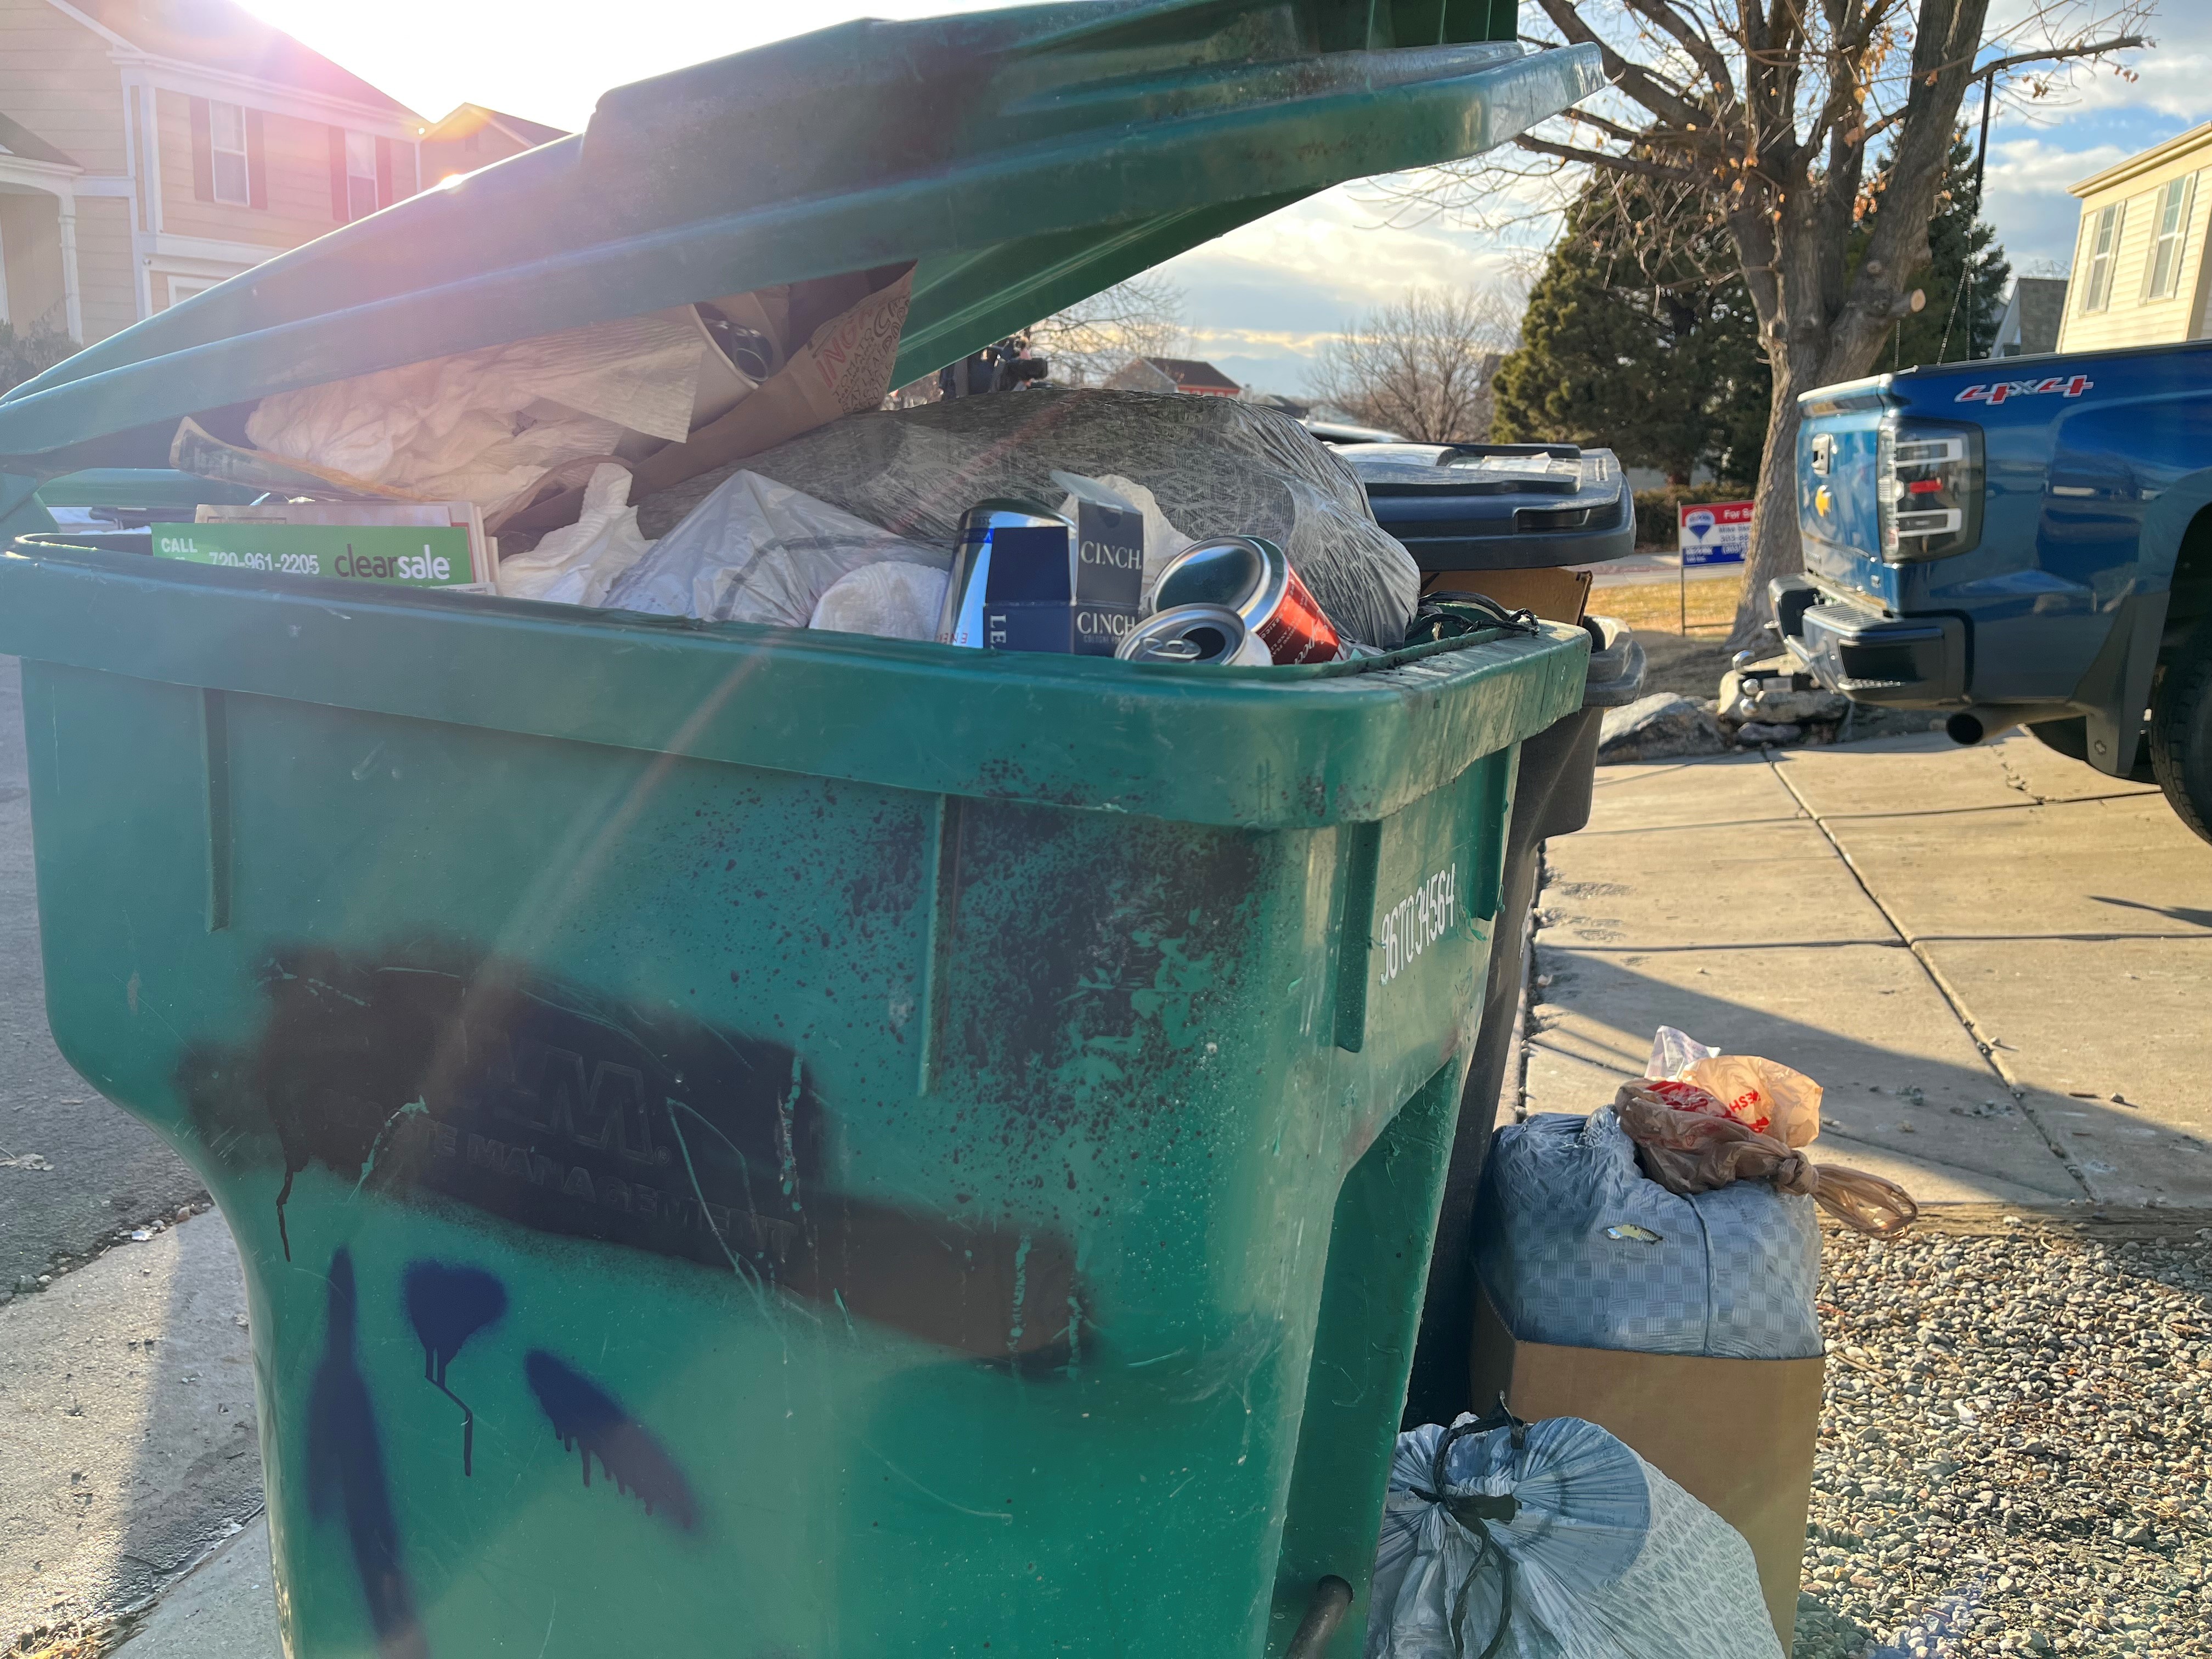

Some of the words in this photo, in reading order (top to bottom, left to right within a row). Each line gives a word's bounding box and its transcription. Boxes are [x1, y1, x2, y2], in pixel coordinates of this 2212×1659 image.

[1724, 509, 1741, 520] For
[161, 537, 199, 554] CALL
[334, 543, 451, 580] clearsale
[989, 614, 1007, 650] LE
[1076, 611, 1137, 640] CINCH
[466, 1133, 799, 1254] MANAGEMENT
